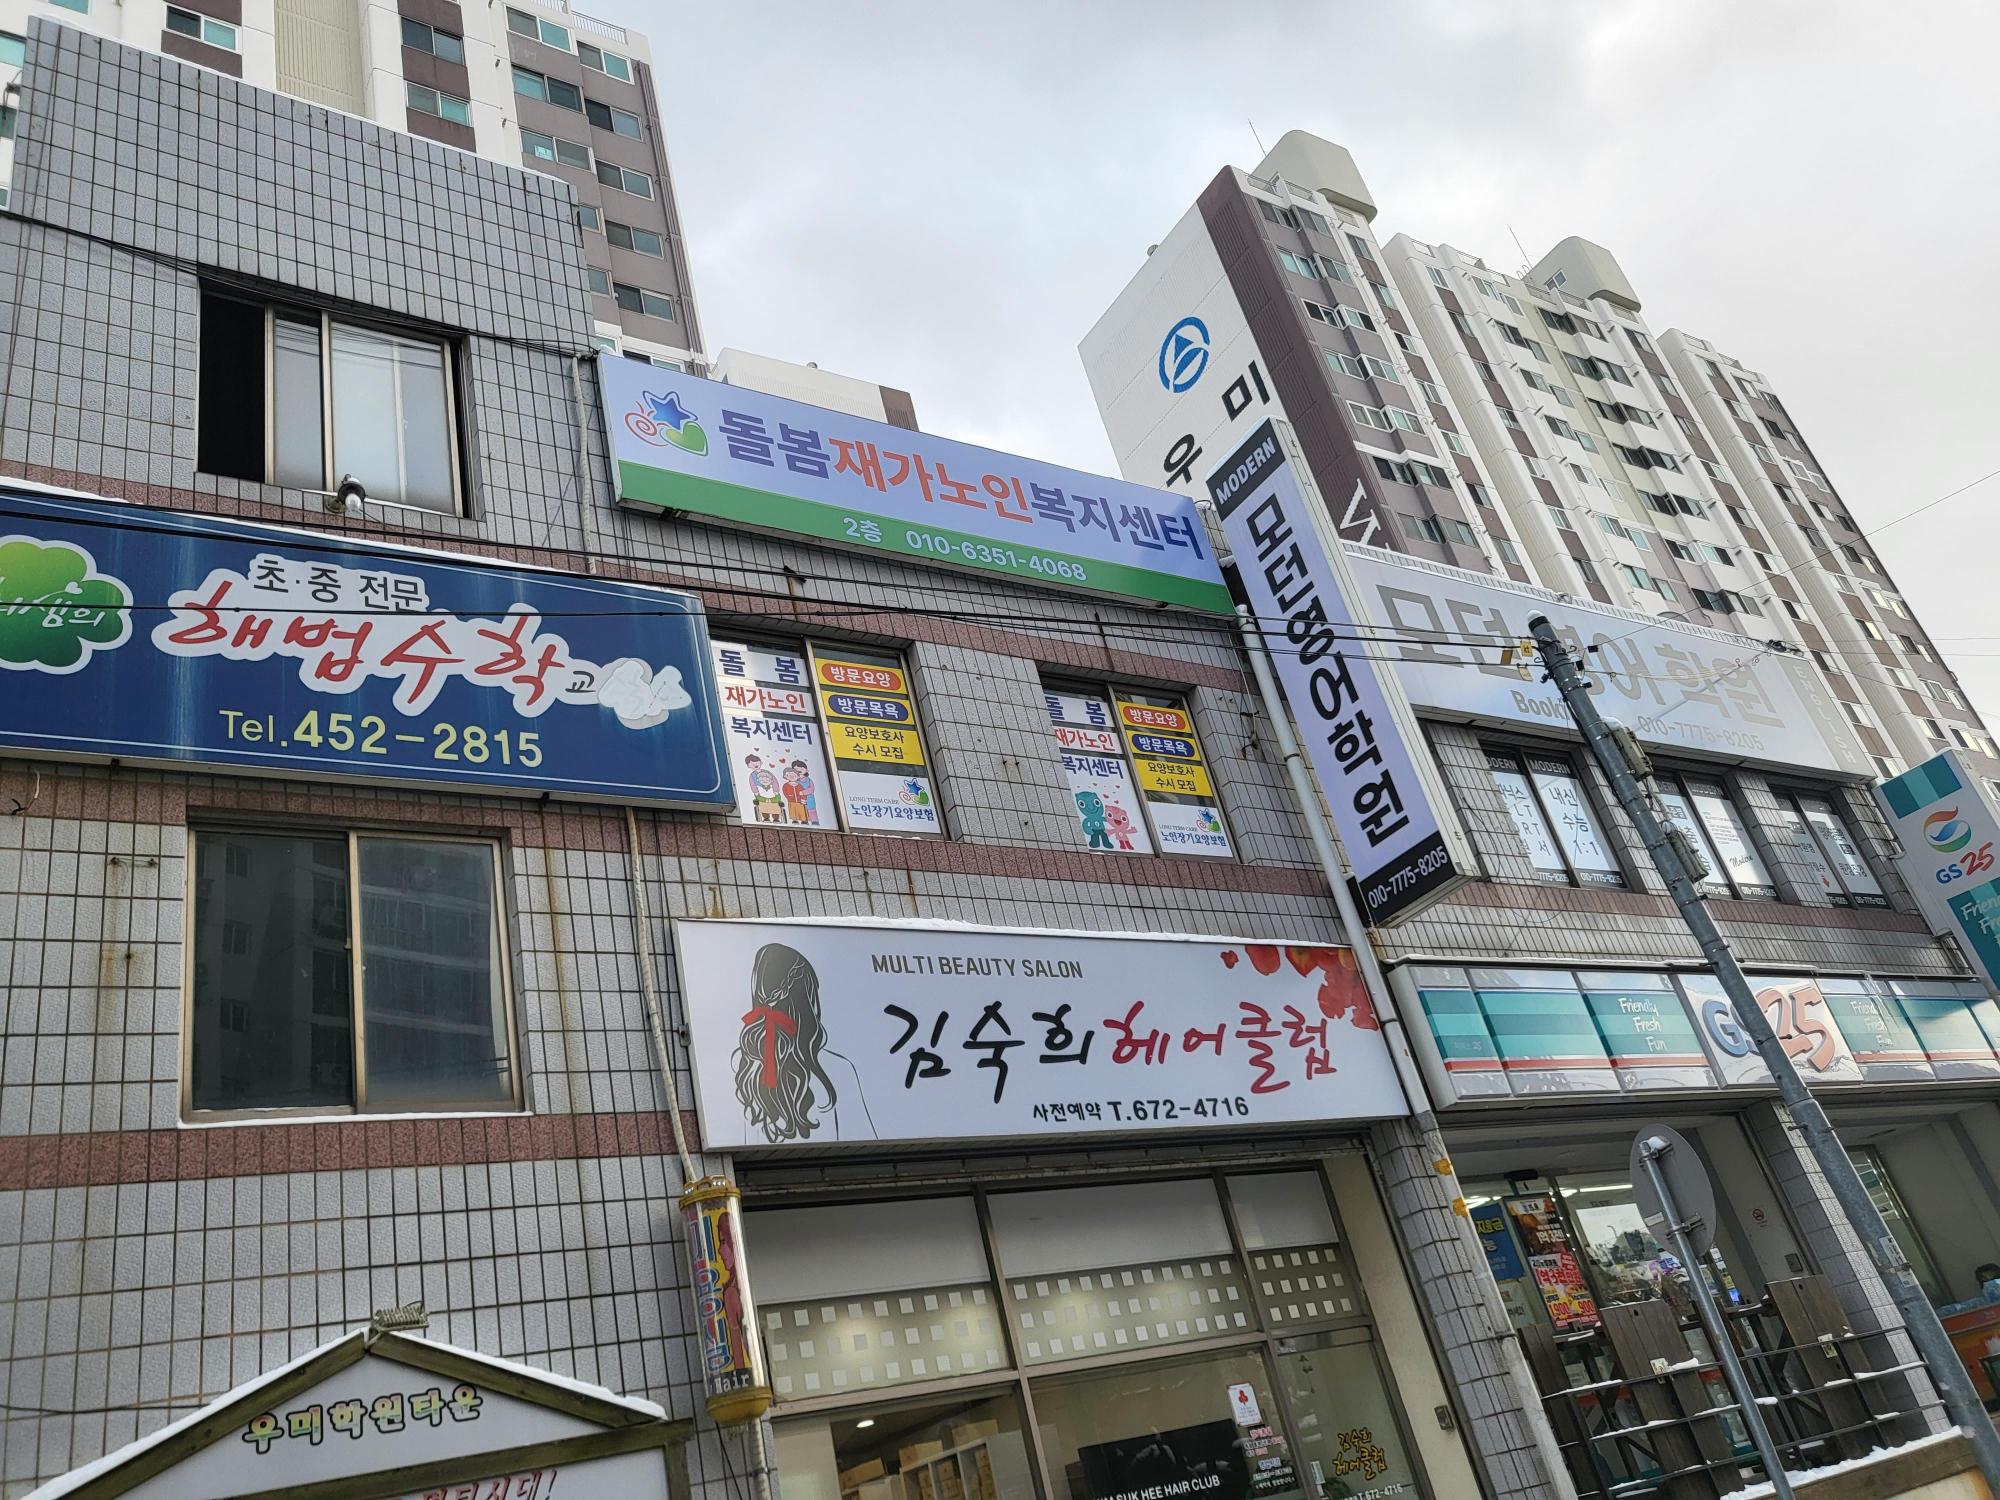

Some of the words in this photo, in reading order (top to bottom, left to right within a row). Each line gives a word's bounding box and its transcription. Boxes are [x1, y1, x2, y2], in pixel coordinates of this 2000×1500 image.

[1215, 436, 1277, 505] MODERN
[719, 409, 1205, 560] 돌봄재가노인복지센터
[842, 516, 883, 544] 2층
[906, 529, 1087, 581] 010-6351-4068
[358, 575, 425, 614] 전문
[830, 666, 891, 688] 방문요양
[1246, 493, 1411, 850] 모던영어학원
[725, 686, 807, 714] 재가노인
[837, 697, 899, 719] 방문목욕
[1129, 708, 1178, 728] 방문요양
[731, 716, 813, 745] 복지센터
[845, 726, 904, 744] 요양보호사
[1638, 714, 1765, 752] 010-7775-8205
[880, 746, 904, 760] 모집
[1138, 736, 1188, 756] 방문목욕
[1061, 755, 1124, 780] 복지센터
[1147, 762, 1196, 777] 요양보호사
[1529, 759, 1571, 774] MODERN
[1177, 779, 1197, 792] 모집
[1549, 787, 1578, 806] 내신
[850, 804, 935, 822] 노인장기요양보험
[1563, 812, 1588, 833] 수능
[1160, 831, 1227, 847] 노인장기요양보험
[1573, 839, 1599, 856] 1:1
[1935, 842, 1995, 885] GS25
[1367, 845, 1450, 909] 010-7775-8205
[872, 953, 937, 976] MULTI
[939, 956, 1016, 978] BEAUTY
[1023, 958, 1083, 979] SALON
[1617, 996, 1659, 1017] Friendly
[1633, 1017, 1661, 1033] Fresh
[1645, 1035, 1667, 1052] Fun
[1033, 1102, 1101, 1123] 사전예약
[1108, 1096, 1249, 1122] T.672-4716
[241, 1383, 484, 1455] 우미학원타운
[1141, 1485, 1163, 1500] HEE
[1164, 1480, 1191, 1497] HAIR
[1191, 1475, 1220, 1491] CLUB
